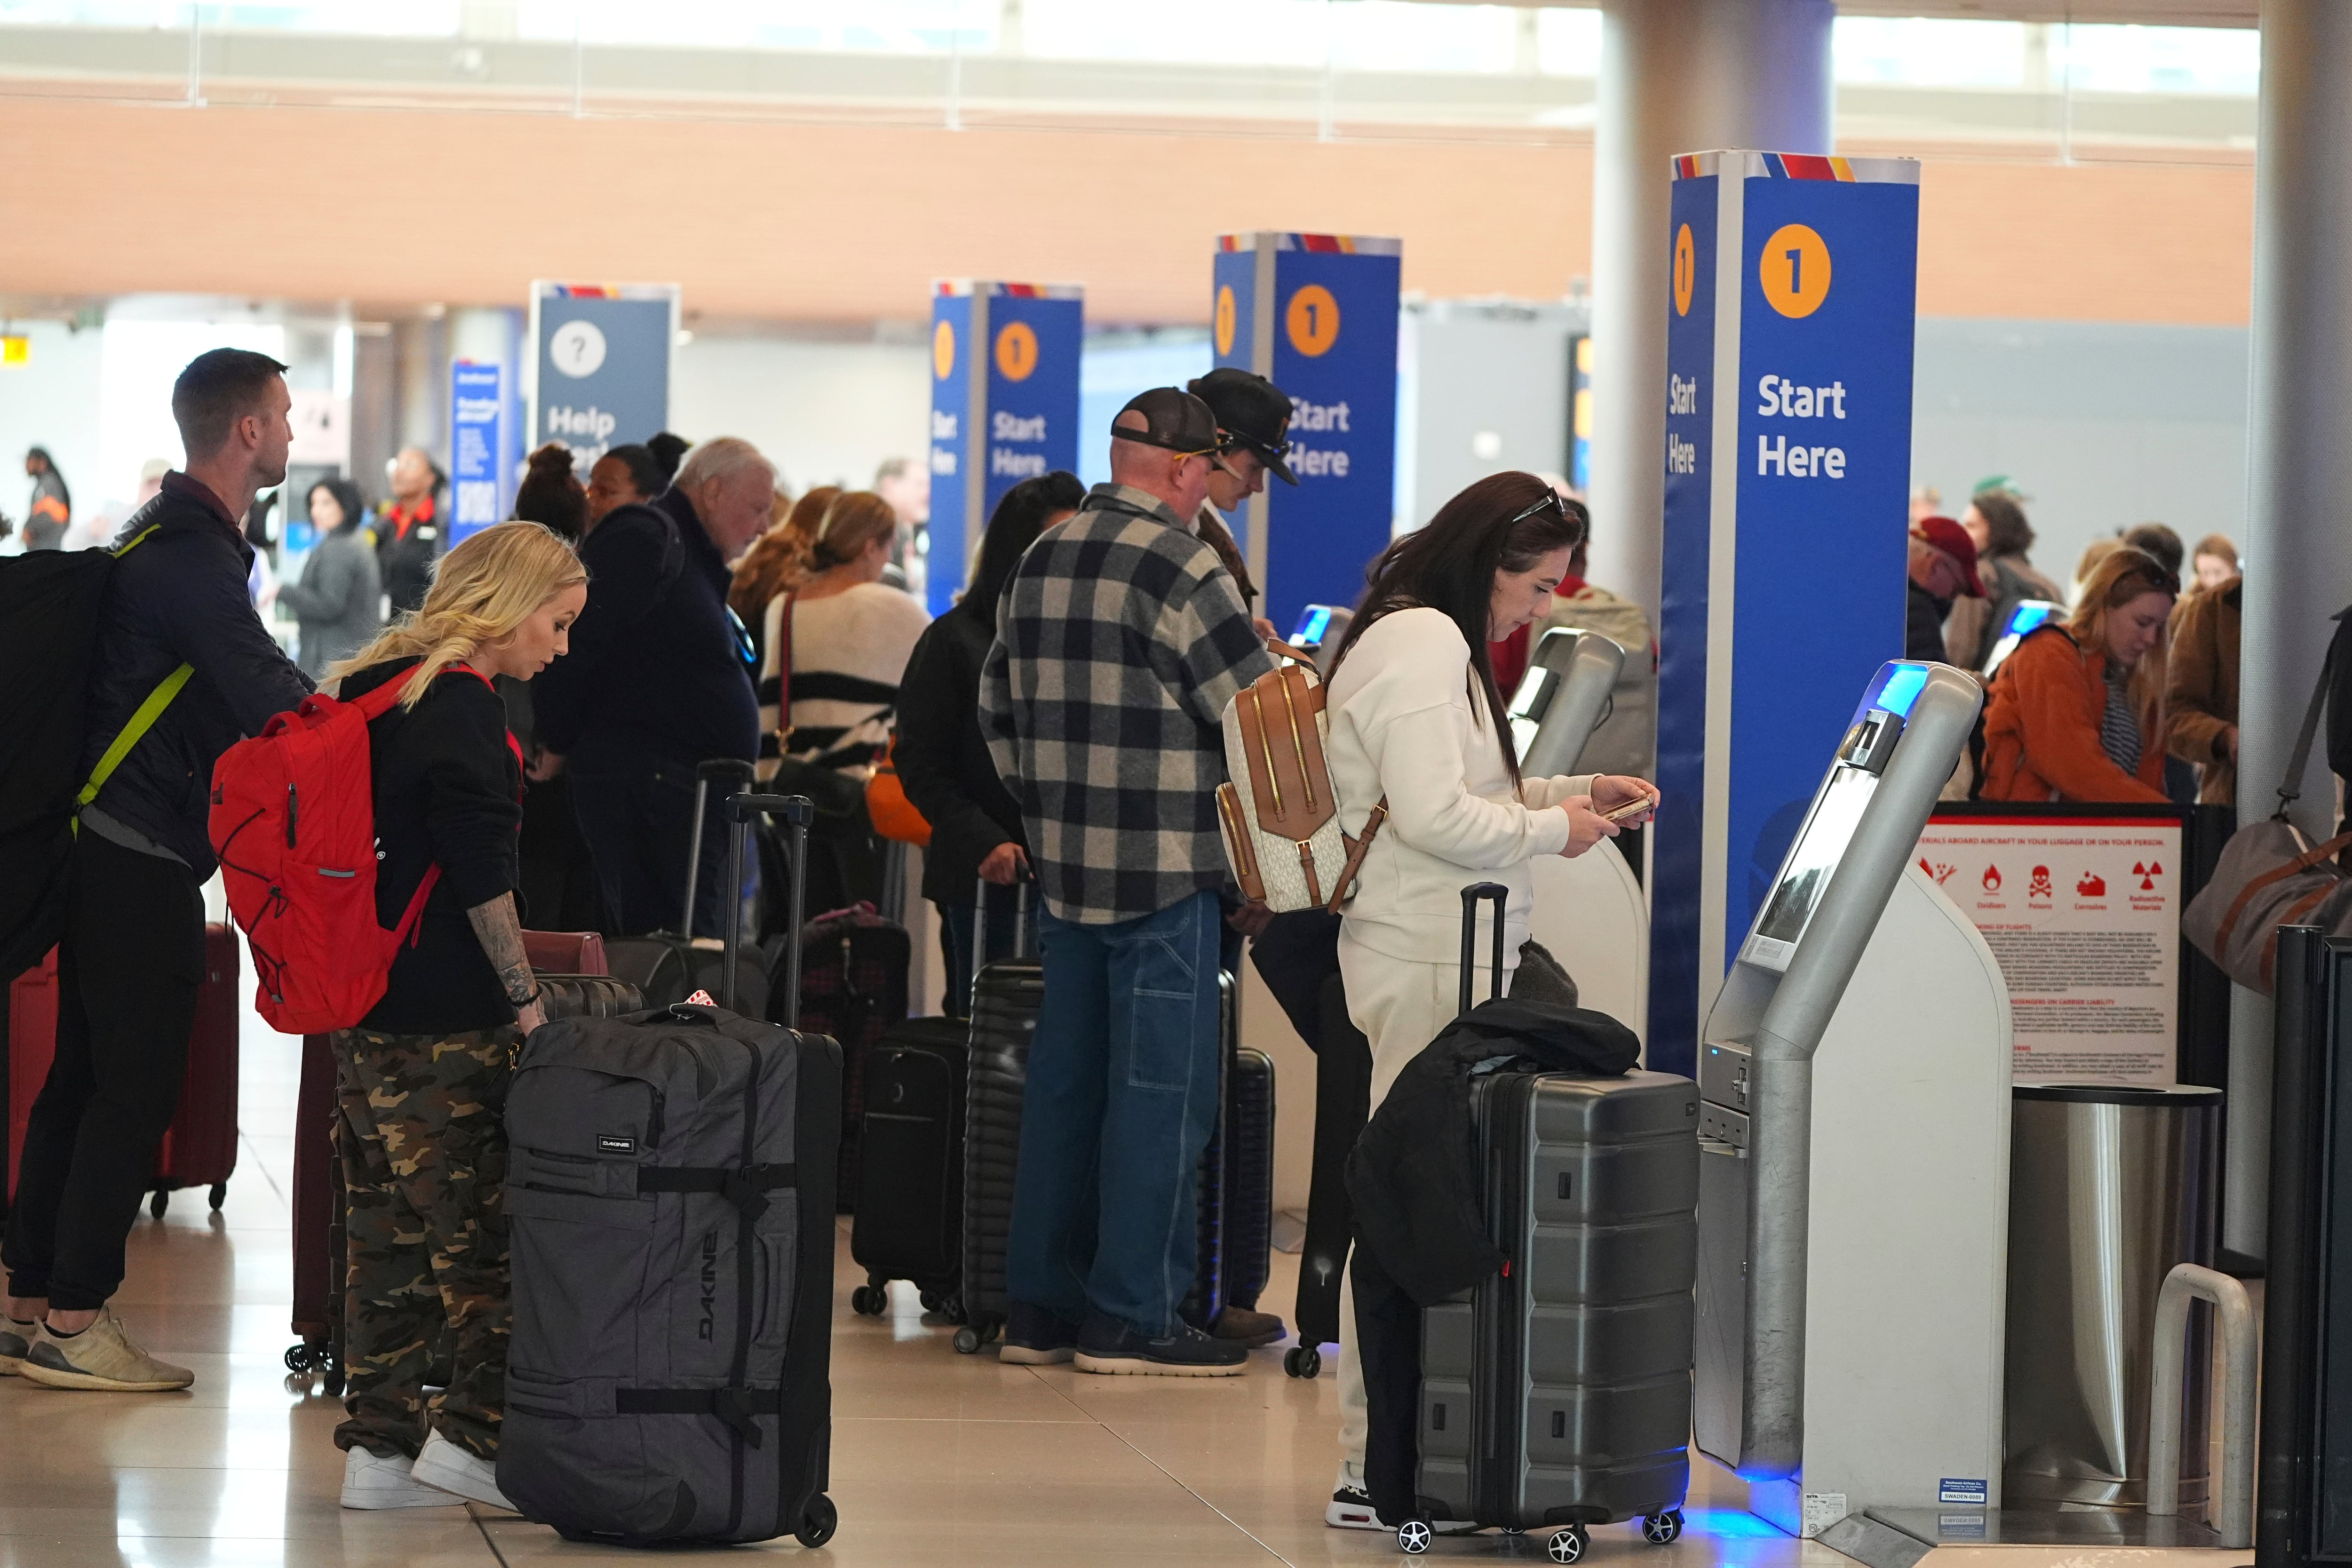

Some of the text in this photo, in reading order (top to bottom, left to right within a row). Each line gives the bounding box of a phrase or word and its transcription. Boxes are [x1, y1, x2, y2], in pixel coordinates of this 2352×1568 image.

[1681, 248, 1687, 292] 1
[1786, 248, 1801, 294] 1
[1306, 303, 1318, 337] 1
[1287, 396, 1350, 432] Start
[1669, 374, 1696, 414] Start
[1758, 374, 1846, 419] Start
[547, 405, 616, 441] Help
[993, 411, 1046, 442] Start
[993, 447, 1047, 478] Here
[1283, 441, 1350, 477] Here
[1668, 433, 1694, 474] Here
[1758, 435, 1846, 478] Here
[699, 1229, 718, 1344] DAKINE
